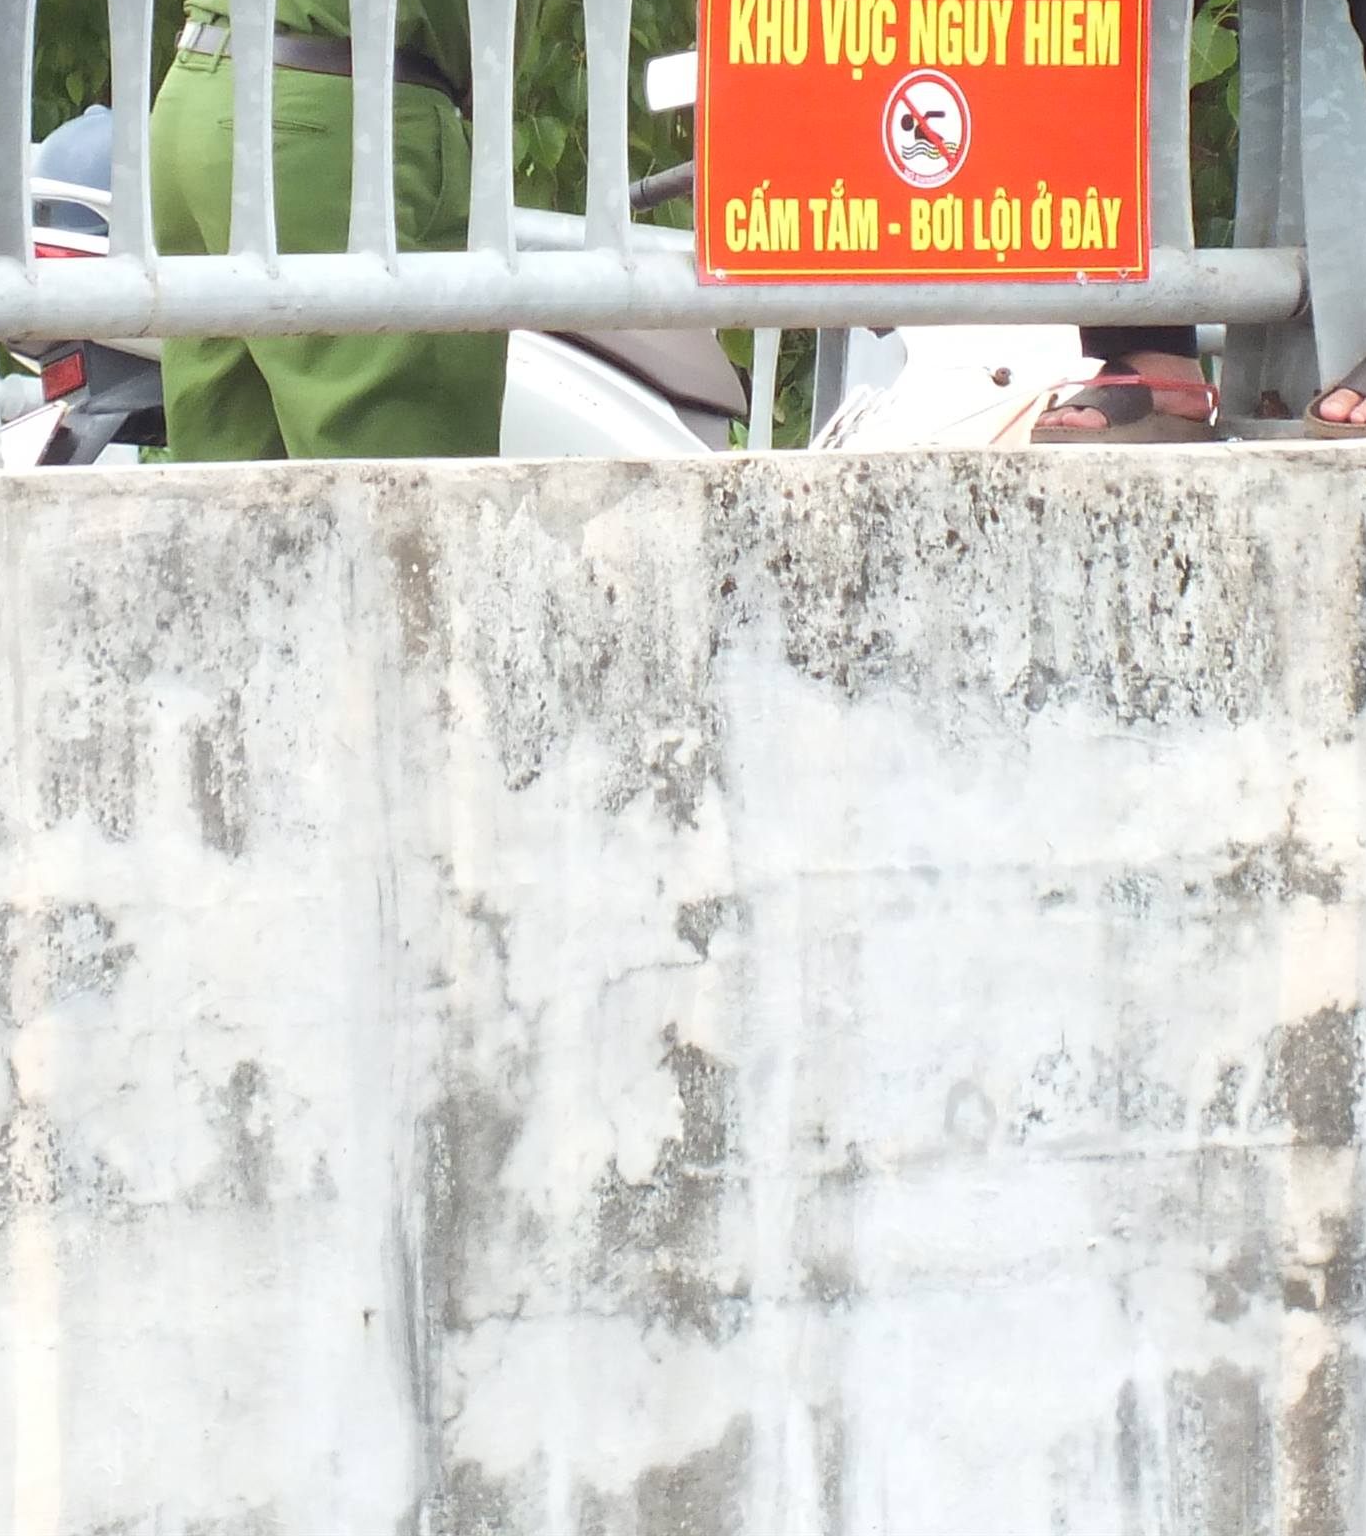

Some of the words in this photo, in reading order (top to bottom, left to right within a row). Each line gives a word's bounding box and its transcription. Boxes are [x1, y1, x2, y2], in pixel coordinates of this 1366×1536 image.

[910, 0, 1012, 65] NGUY
[726, 181, 798, 251] CẤM
[810, 180, 877, 250] TẮM
[889, 224, 900, 234] -
[911, 194, 962, 250] BƠI
[974, 188, 1020, 261] LỘI
[1032, 182, 1051, 249] Ở
[1061, 188, 1120, 248] ĐÂY
